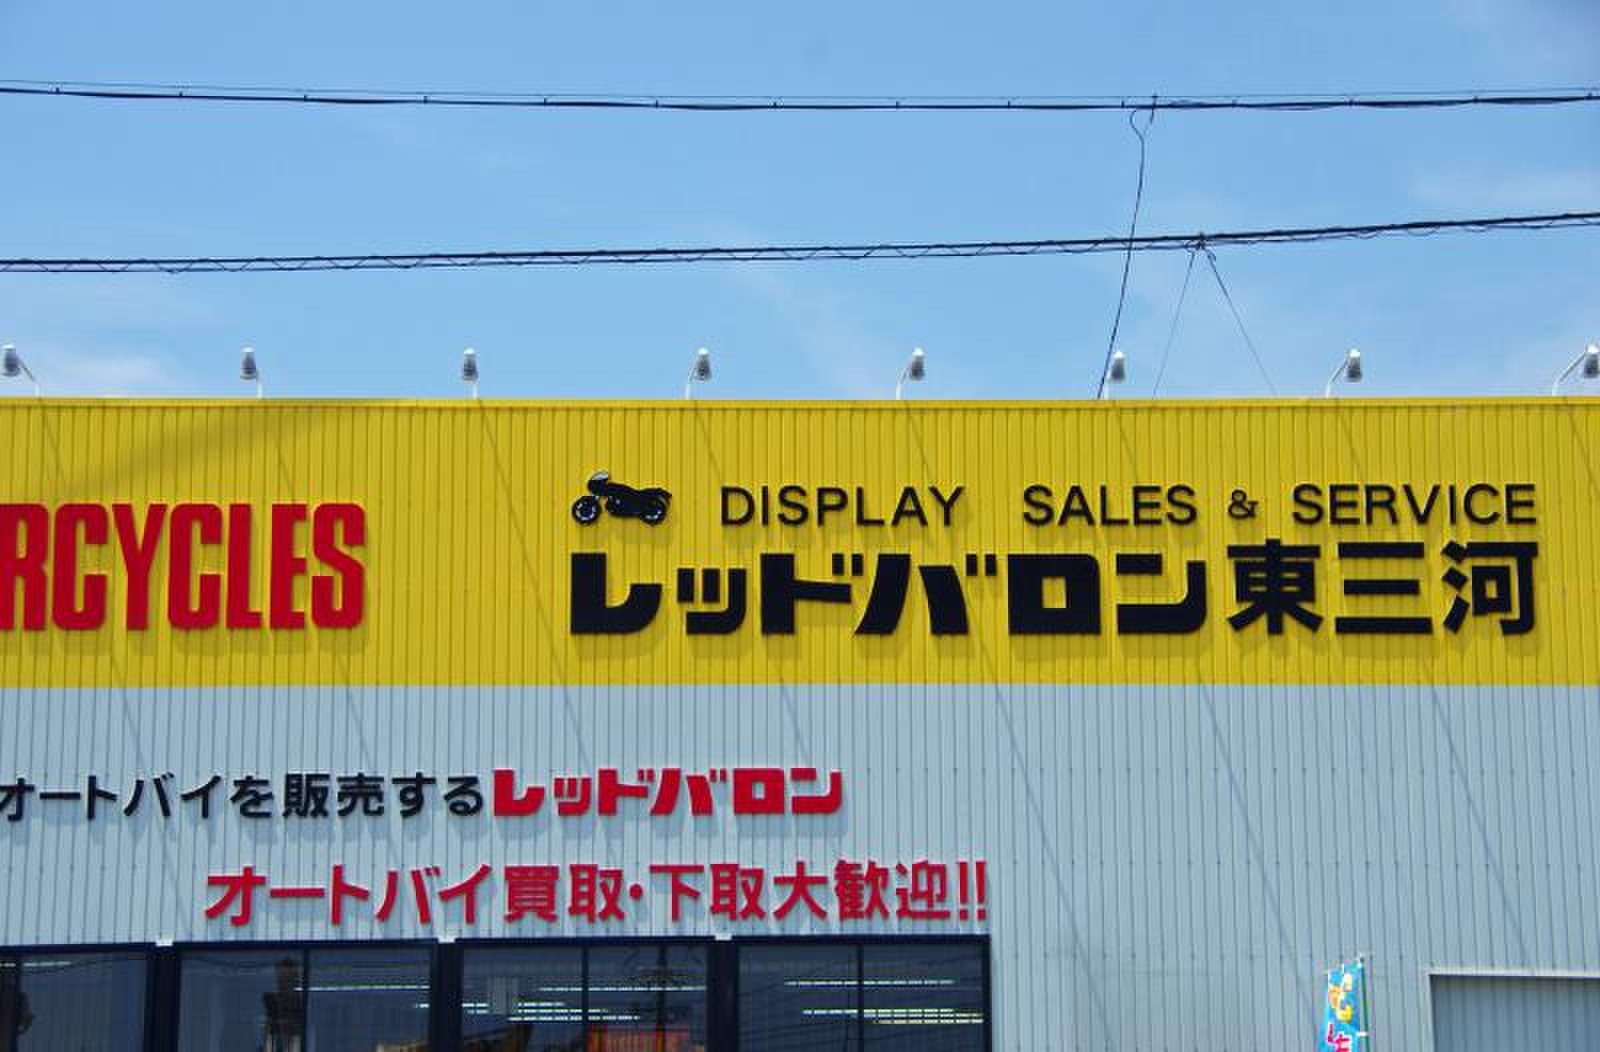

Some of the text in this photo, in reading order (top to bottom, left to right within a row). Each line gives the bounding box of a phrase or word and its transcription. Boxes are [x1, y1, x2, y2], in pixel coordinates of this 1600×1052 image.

[721, 483, 1537, 527] DISPLAY SALES & SERVICE
[0, 502, 366, 632] RCYCLES
